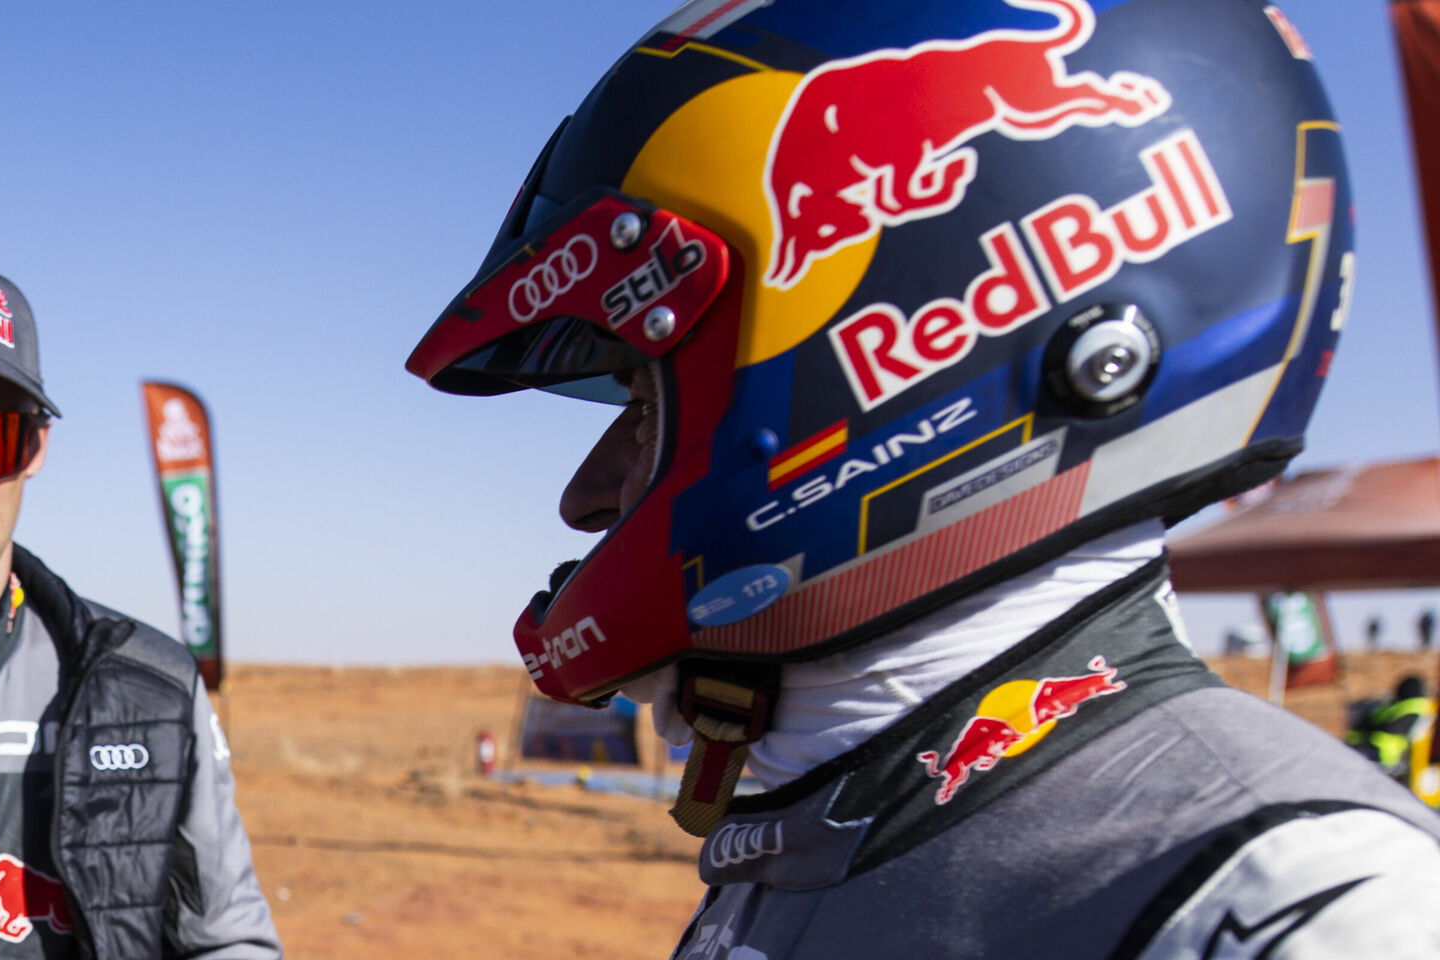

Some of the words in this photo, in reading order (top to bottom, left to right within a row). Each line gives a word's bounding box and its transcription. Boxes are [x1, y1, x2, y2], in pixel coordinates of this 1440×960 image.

[828, 221, 1052, 412] Red
[1020, 128, 1233, 303] Bull
[746, 397, 978, 531] C.SAINZ
[742, 574, 779, 598] 173
